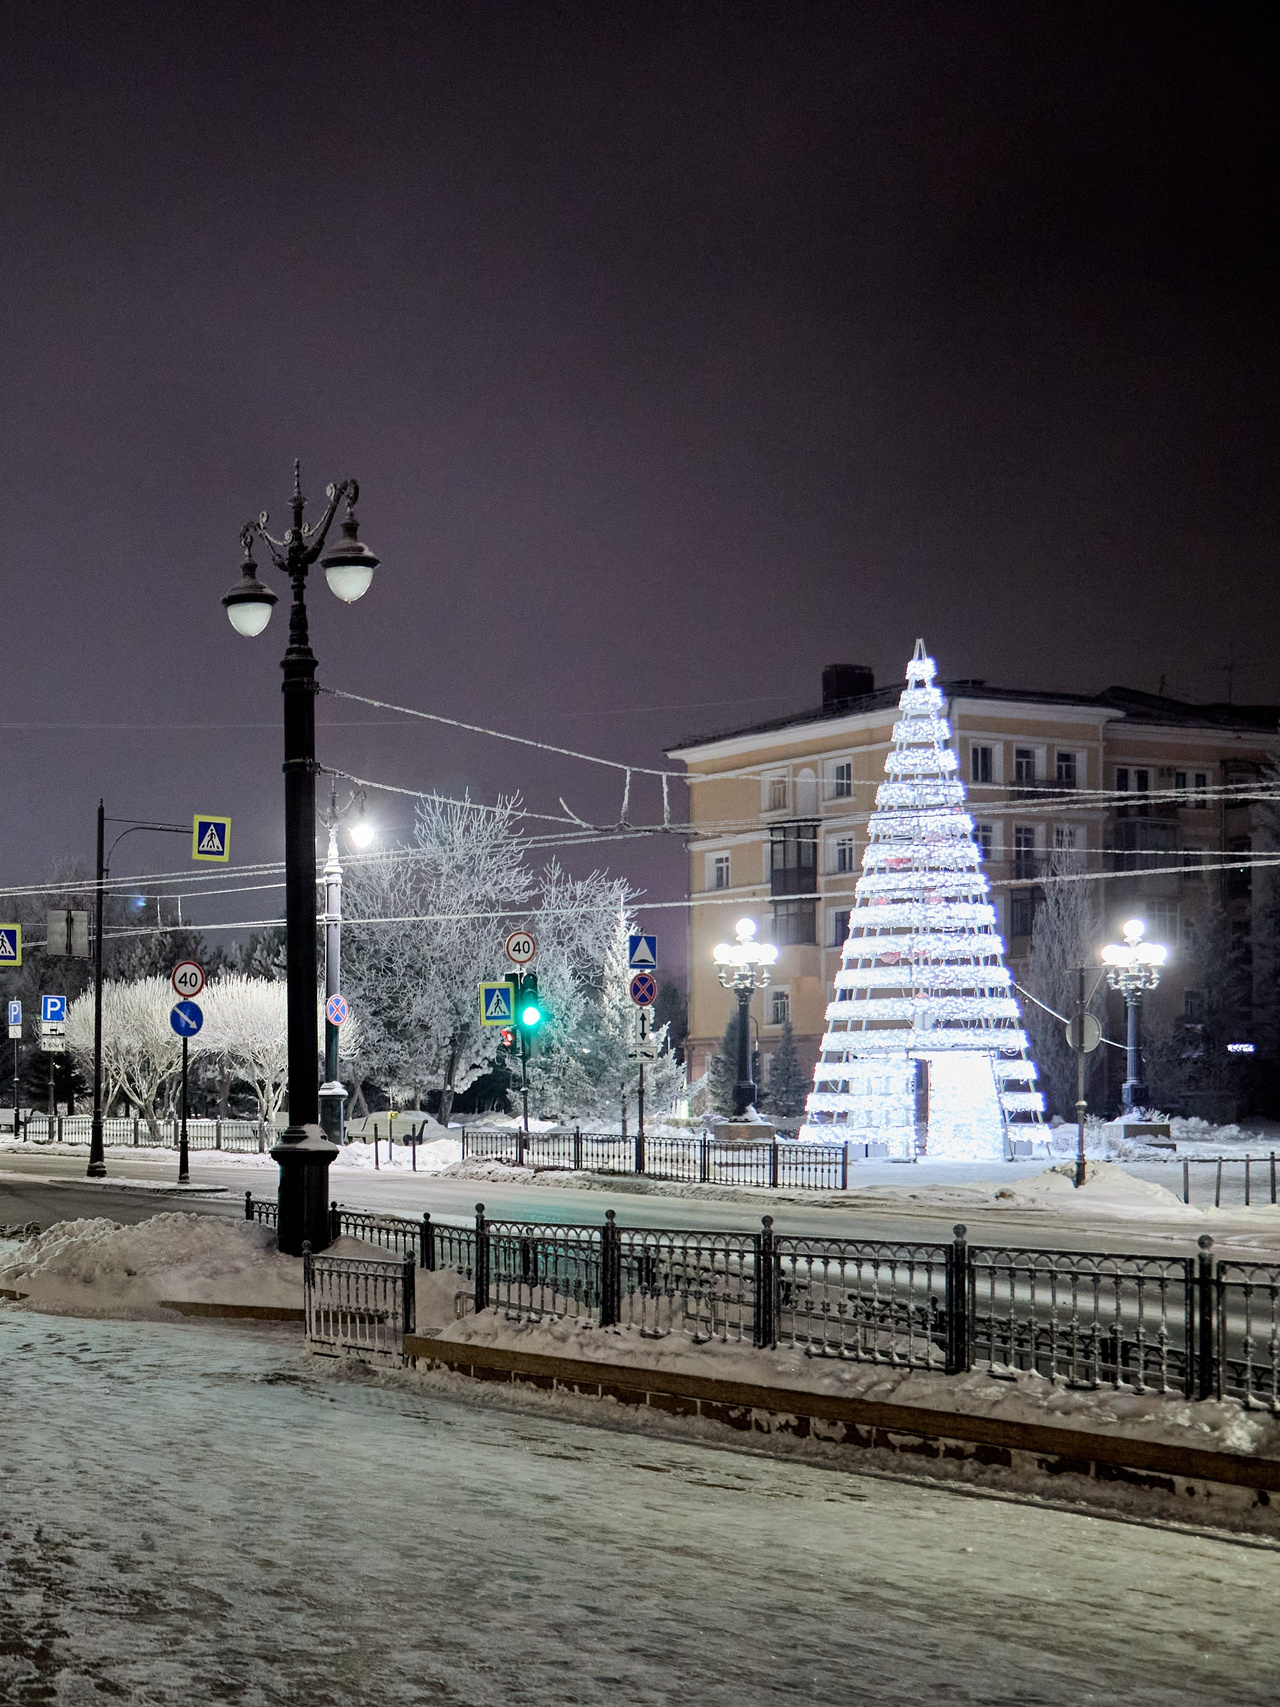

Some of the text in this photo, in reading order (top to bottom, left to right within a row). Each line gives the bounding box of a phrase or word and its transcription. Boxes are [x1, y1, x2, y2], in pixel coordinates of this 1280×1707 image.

[512, 940, 531, 955] 40
[178, 972, 198, 987] 40
[11, 1003, 19, 1022] P
[47, 998, 61, 1019] P
